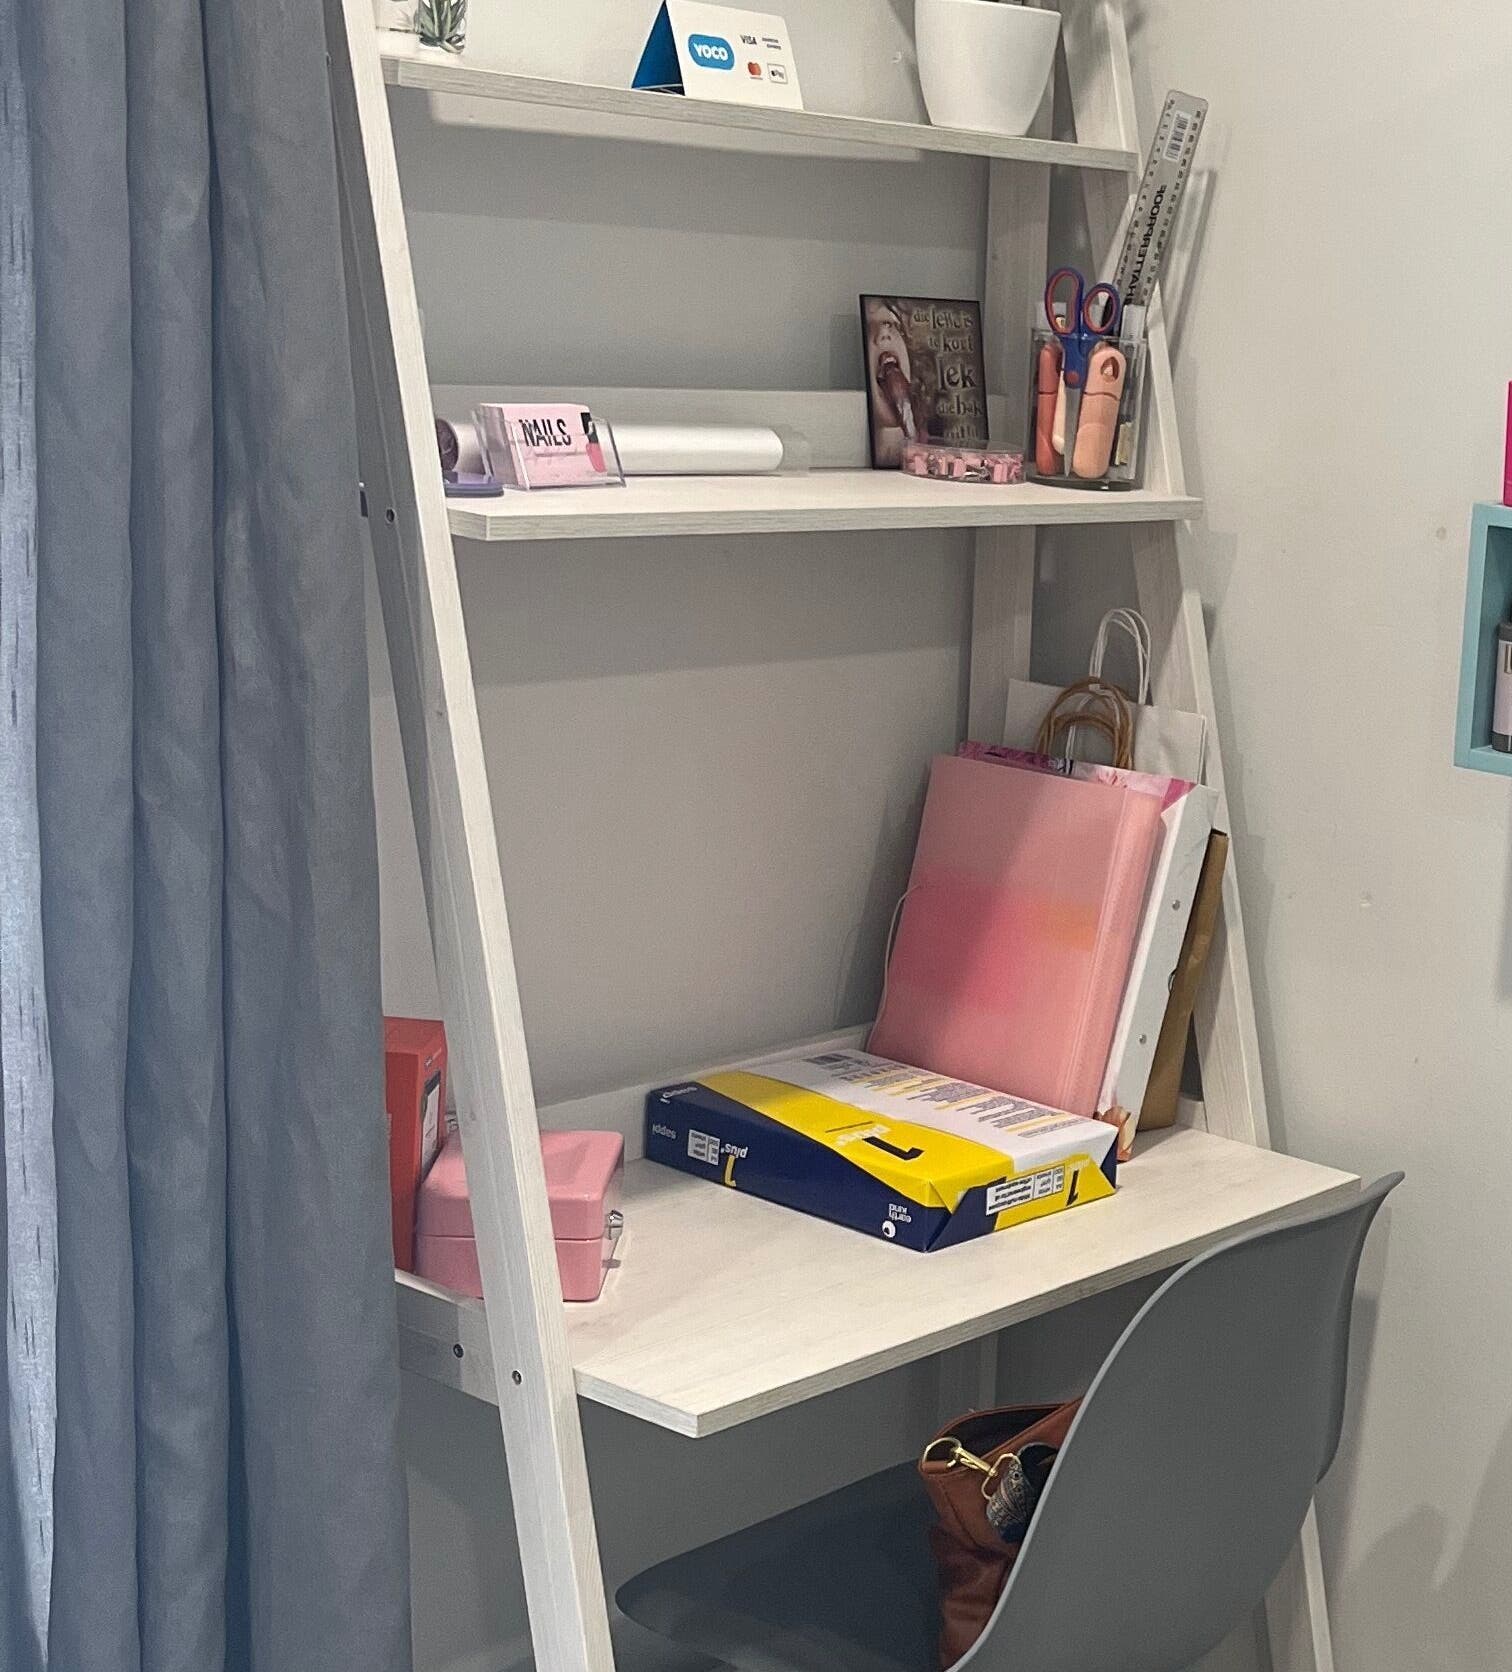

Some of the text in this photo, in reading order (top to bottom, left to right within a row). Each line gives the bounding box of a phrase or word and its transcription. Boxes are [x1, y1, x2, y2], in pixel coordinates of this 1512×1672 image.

[694, 43, 728, 62] YOCO
[938, 359, 976, 391] lek
[518, 418, 572, 447] NAILS
[725, 1143, 748, 1158] plus
